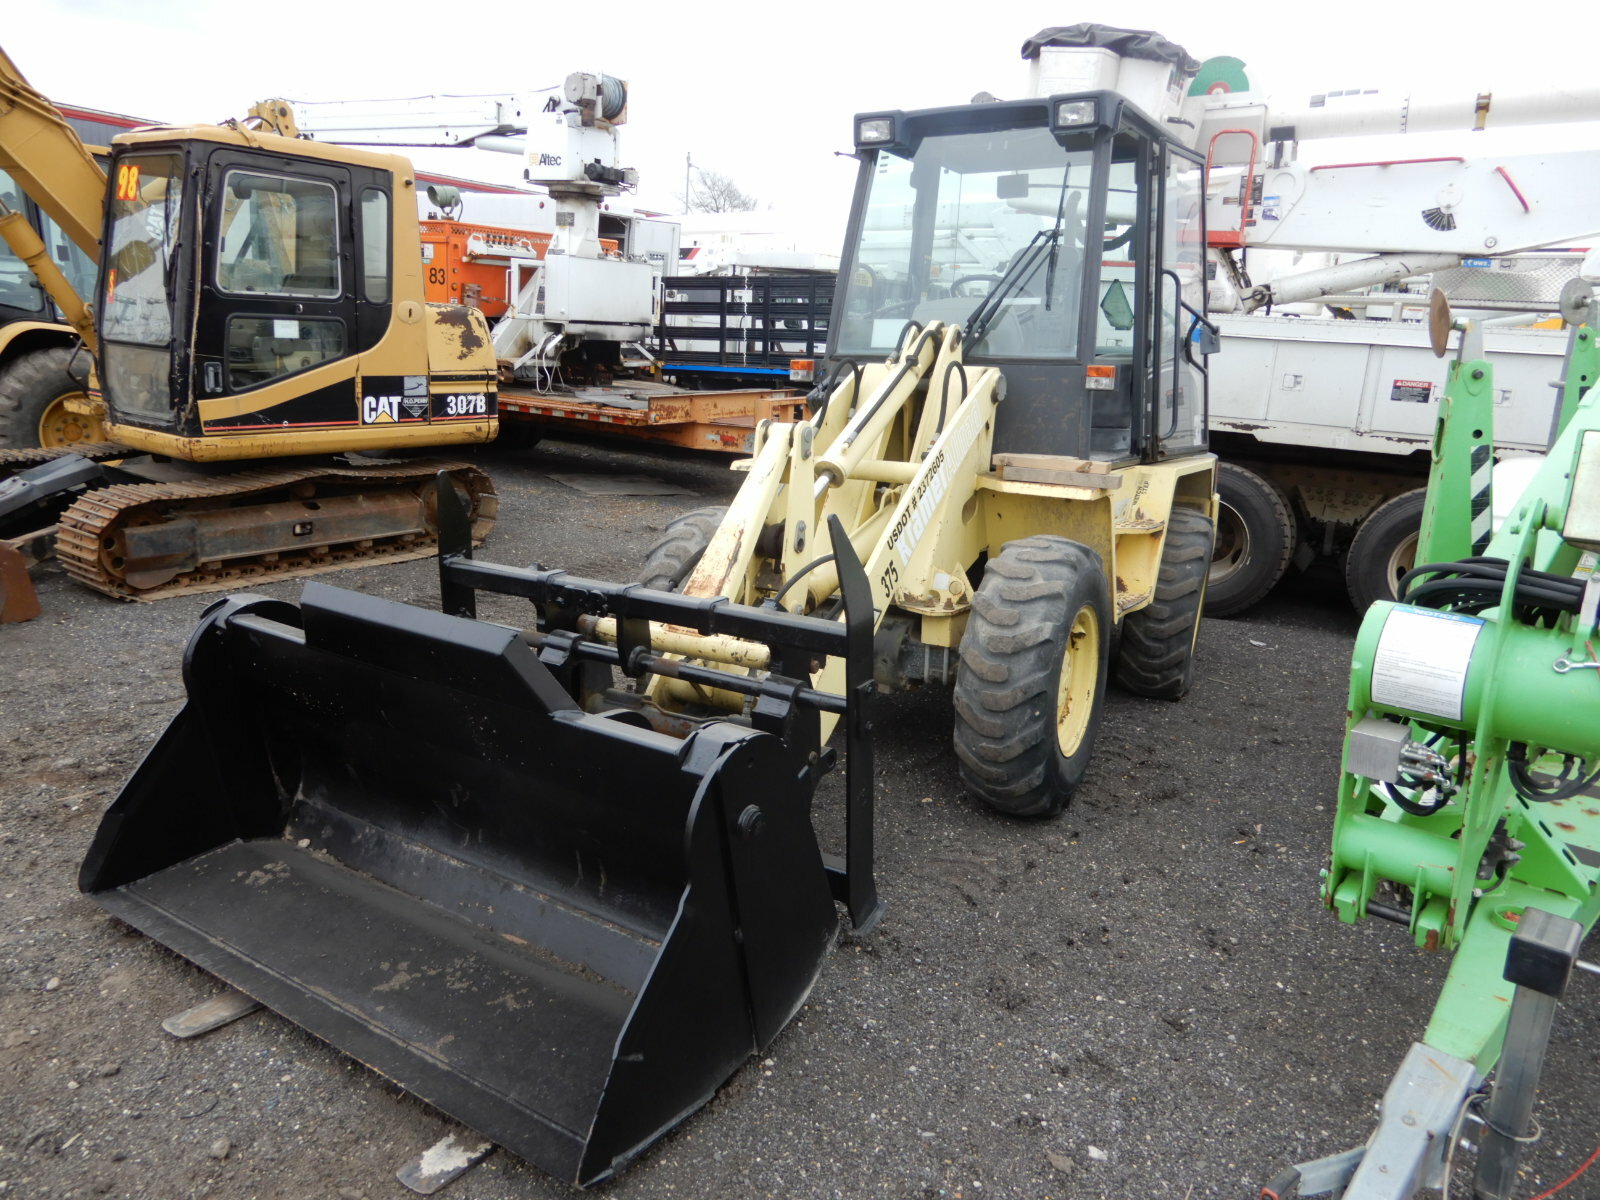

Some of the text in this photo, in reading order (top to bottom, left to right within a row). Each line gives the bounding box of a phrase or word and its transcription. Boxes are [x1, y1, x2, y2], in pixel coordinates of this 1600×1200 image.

[539, 153, 562, 166] Altec
[119, 166, 139, 199] 98
[429, 267, 445, 285] 83
[1402, 380, 1429, 388] DANGER
[363, 395, 401, 423] CAT
[447, 395, 487, 415] 307B
[887, 449, 945, 550] USDOT # 2372605
[895, 458, 952, 567] Kramer
[881, 559, 899, 598] 375
[1414, 608, 1460, 620] NOTICE
